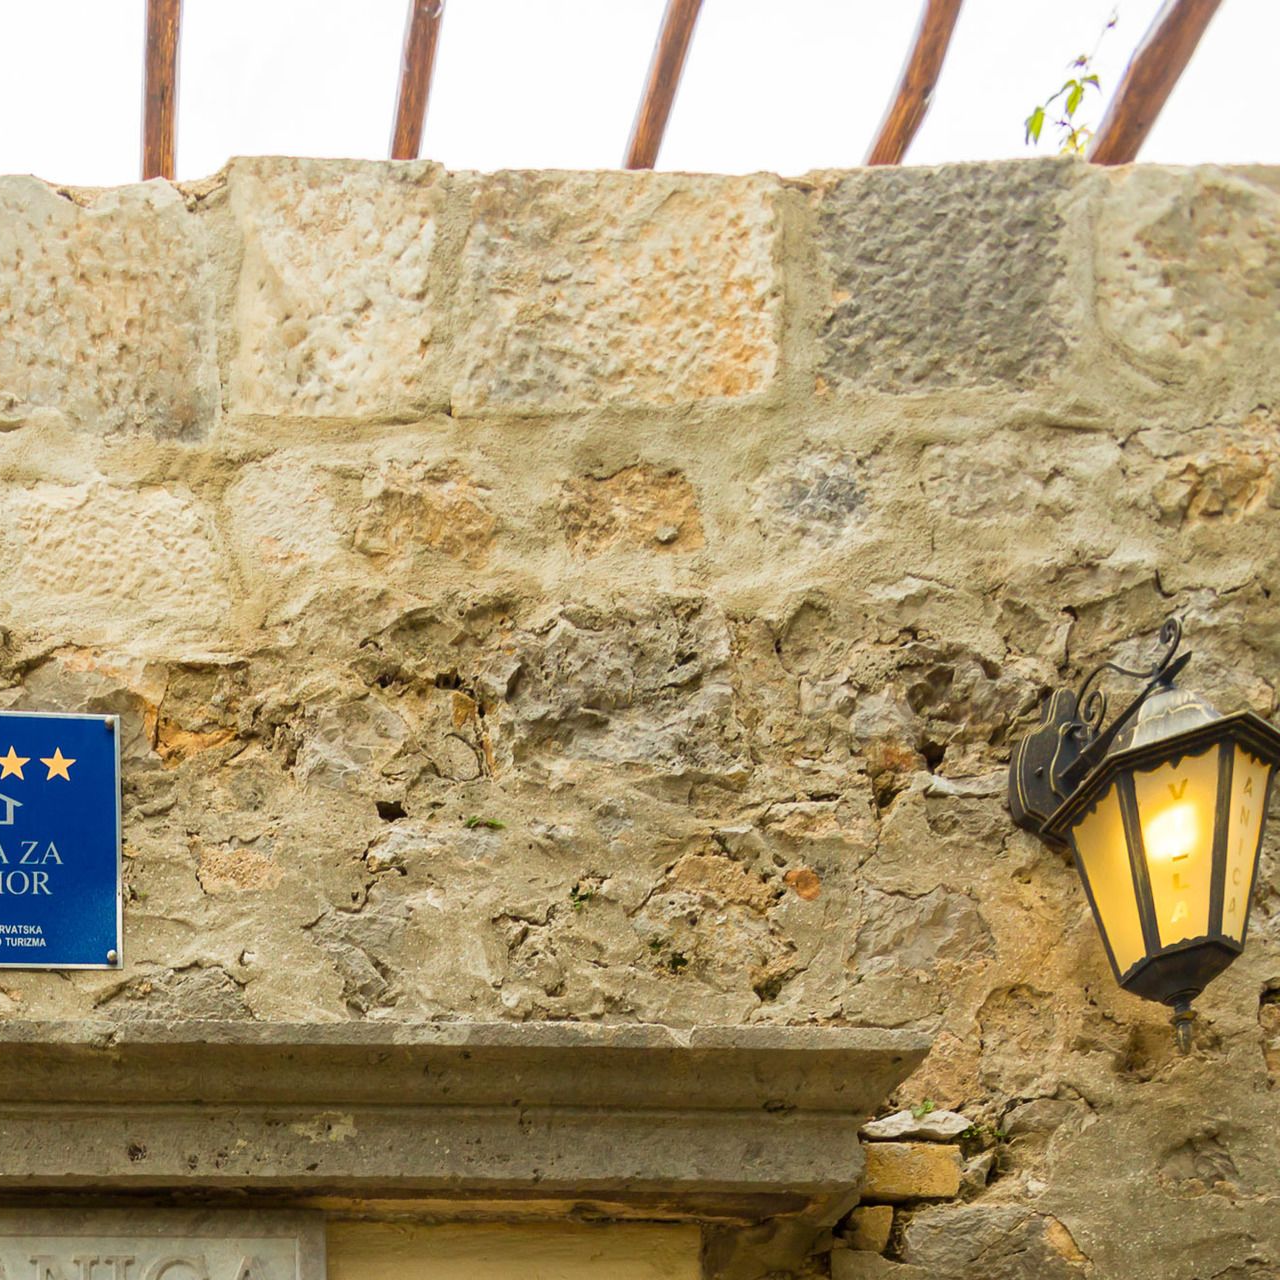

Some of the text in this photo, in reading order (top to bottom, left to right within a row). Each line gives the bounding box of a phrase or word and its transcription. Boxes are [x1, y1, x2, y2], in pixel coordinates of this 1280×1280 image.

[19, 840, 64, 865] ZA
[1226, 776, 1254, 913] ANICA
[5, 937, 47, 947] TURIZMA
